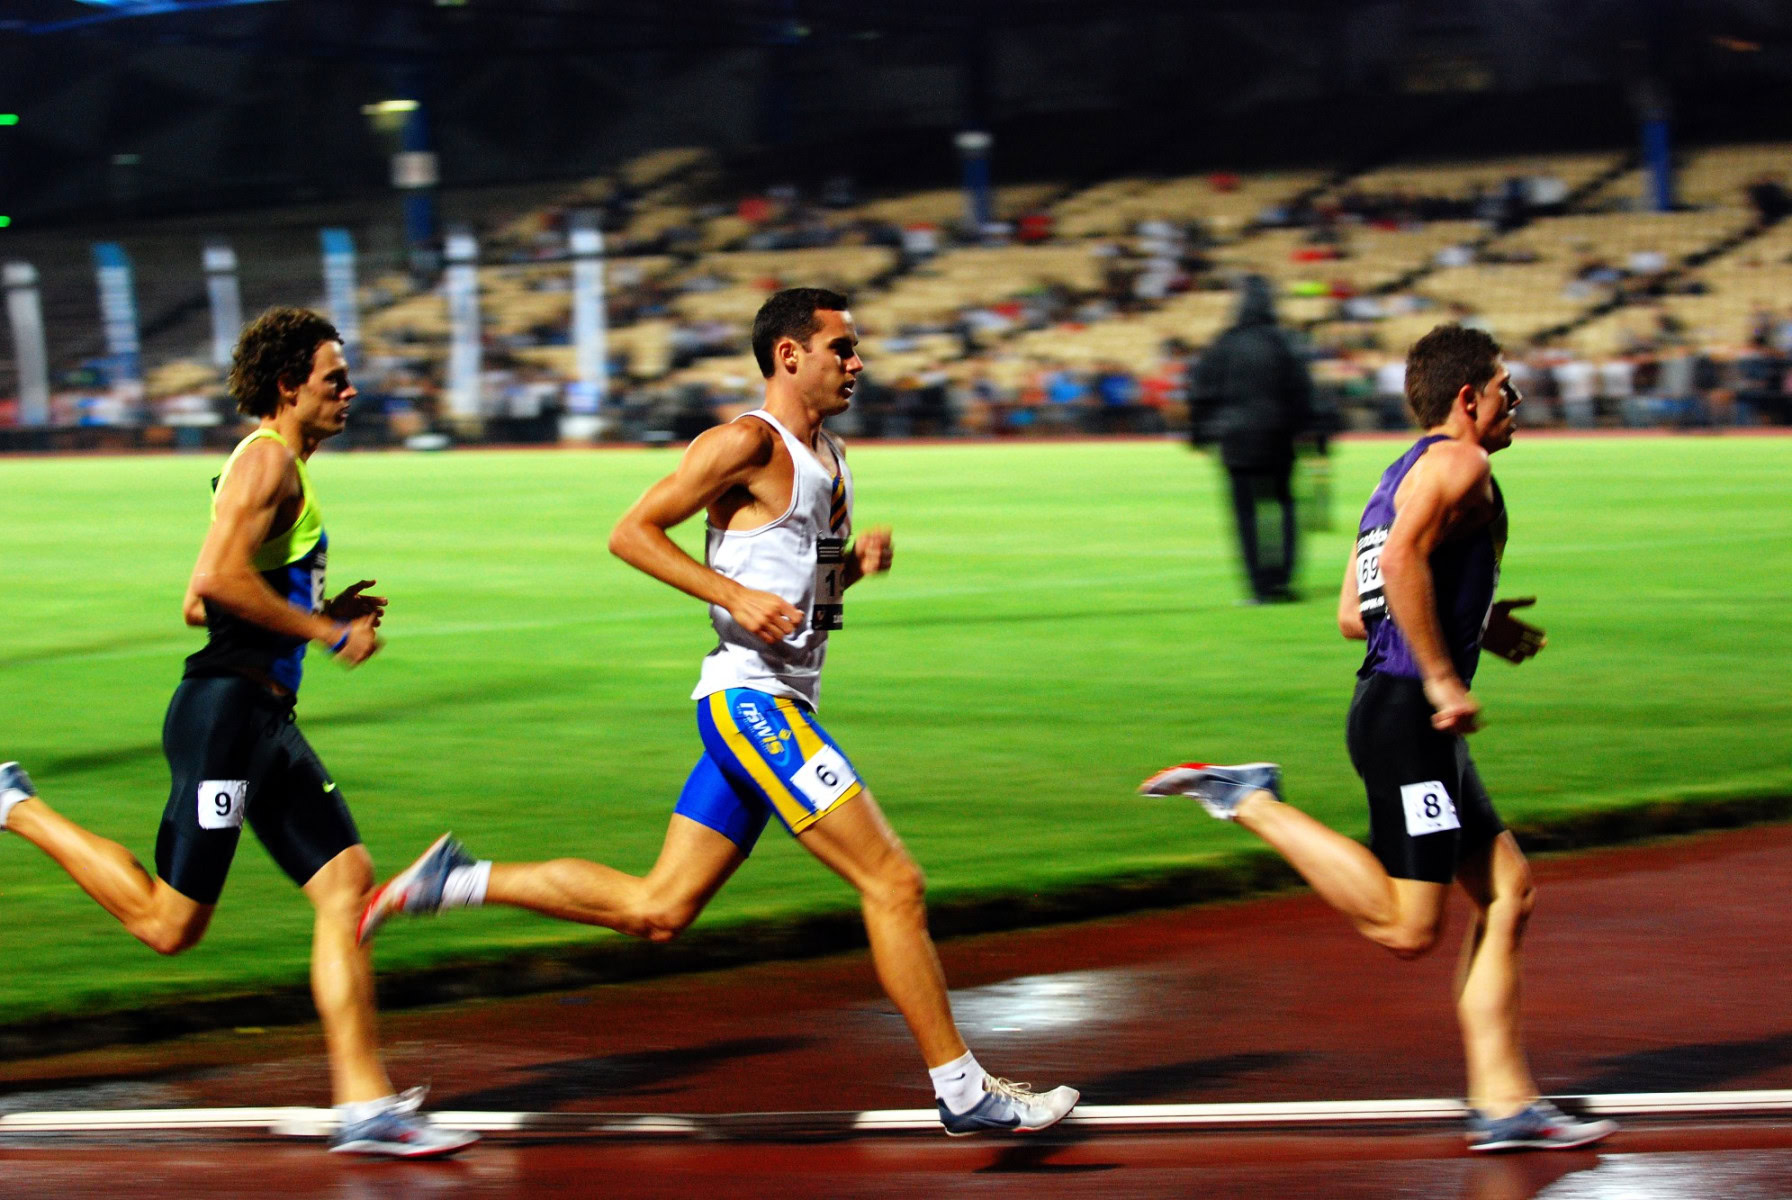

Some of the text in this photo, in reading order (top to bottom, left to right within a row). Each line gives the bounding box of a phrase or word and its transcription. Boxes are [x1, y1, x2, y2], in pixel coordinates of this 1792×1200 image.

[815, 764, 838, 787] 6
[214, 791, 232, 817] 9
[1423, 793, 1441, 819] 8
